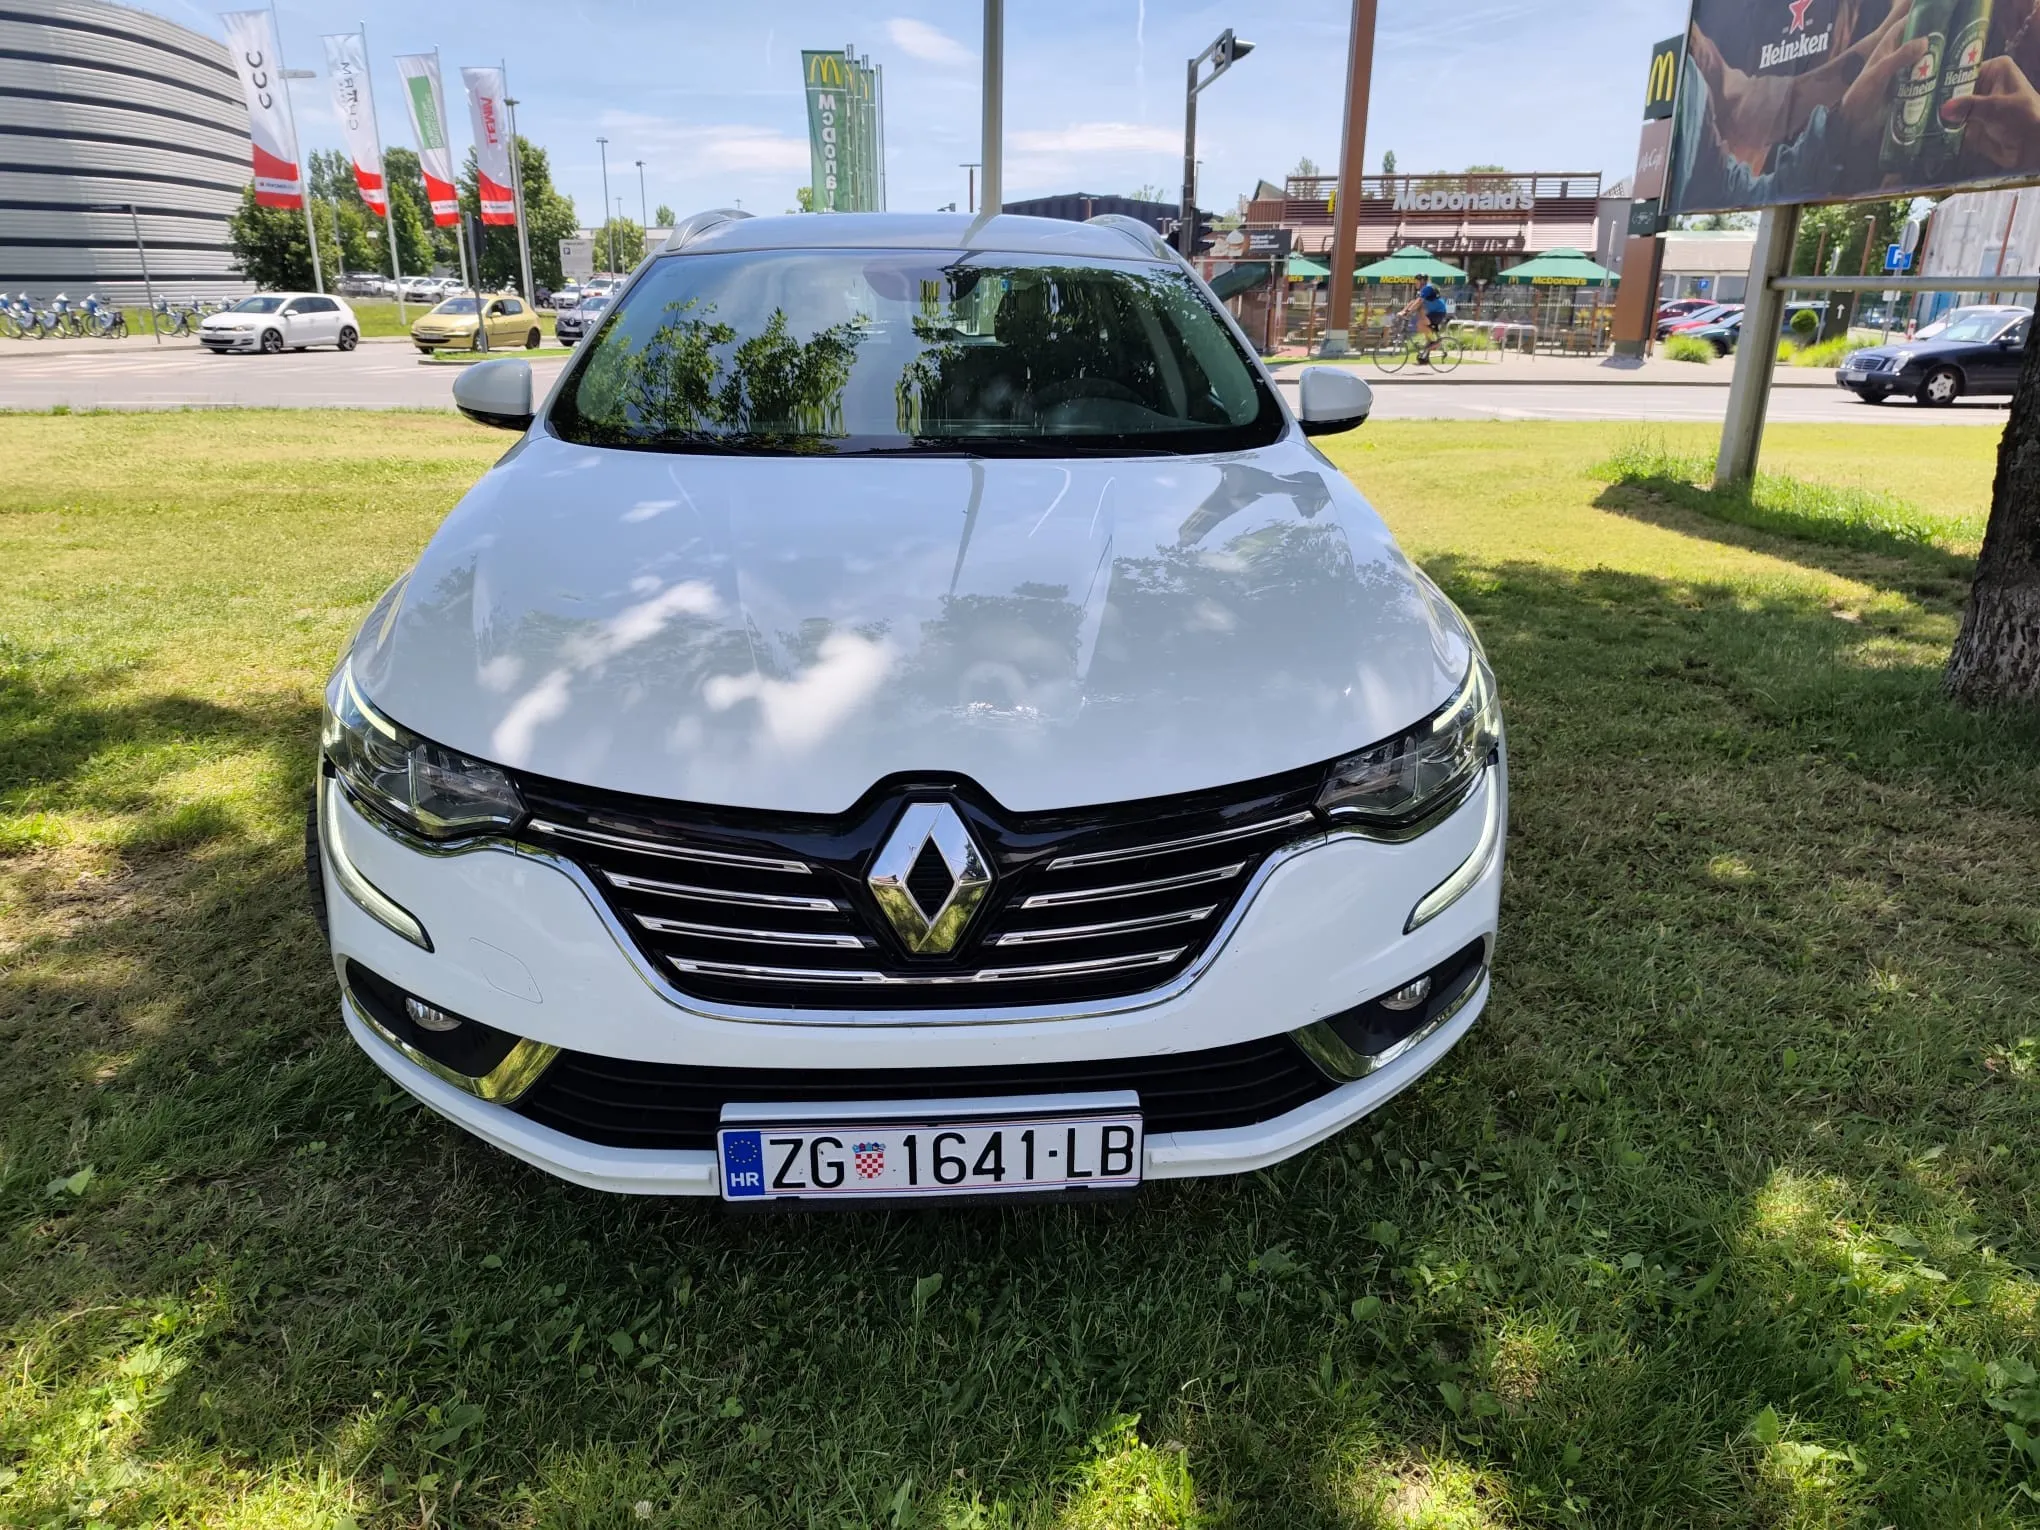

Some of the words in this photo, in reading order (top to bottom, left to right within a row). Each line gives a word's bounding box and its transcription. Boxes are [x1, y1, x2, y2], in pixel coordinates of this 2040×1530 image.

[1758, 31, 1830, 70] Heineken
[246, 50, 273, 110] CCC
[1391, 190, 1535, 211] McDonald's
[730, 1172, 760, 1187] HR
[769, 1136, 845, 1189] ZG
